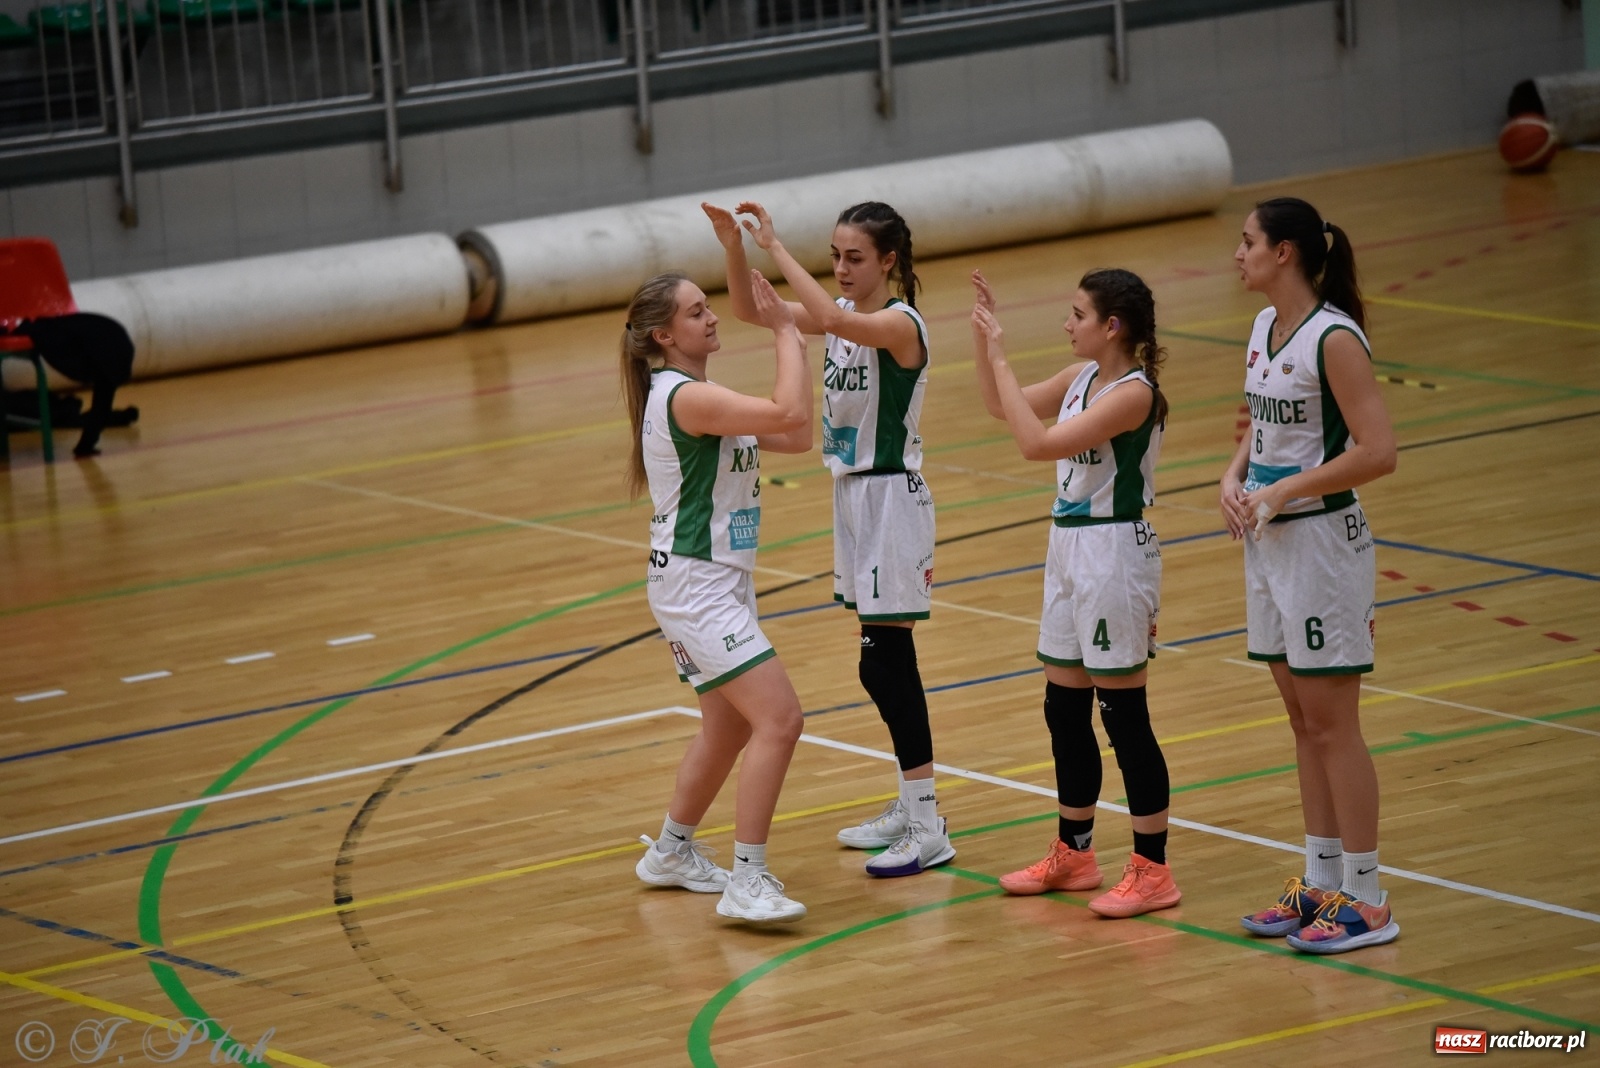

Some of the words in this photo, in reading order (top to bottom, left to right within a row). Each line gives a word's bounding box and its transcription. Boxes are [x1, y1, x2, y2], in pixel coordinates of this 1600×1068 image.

[1255, 428, 1263, 455] 6
[1062, 467, 1074, 492] 4
[871, 565, 880, 599] 1
[1092, 618, 1112, 652] 4
[1304, 616, 1325, 651] 6
